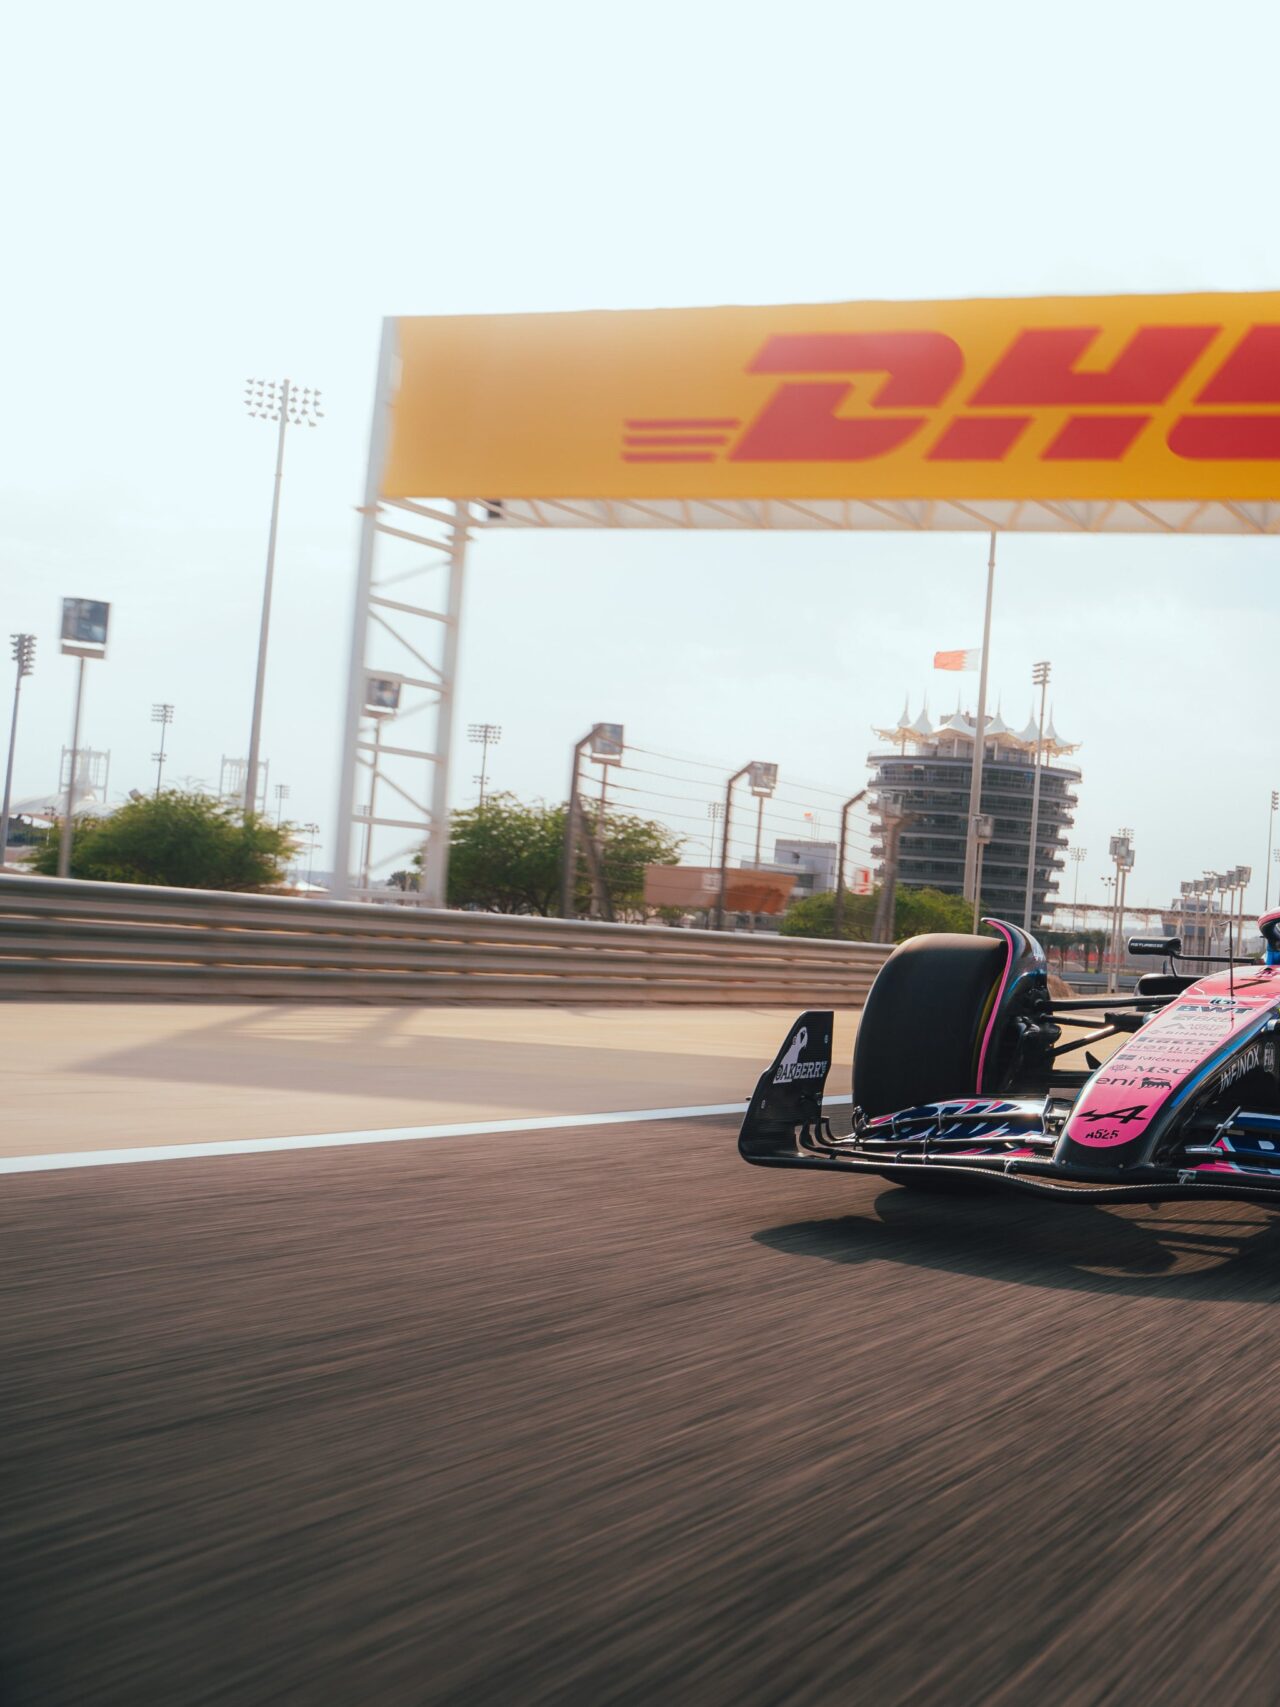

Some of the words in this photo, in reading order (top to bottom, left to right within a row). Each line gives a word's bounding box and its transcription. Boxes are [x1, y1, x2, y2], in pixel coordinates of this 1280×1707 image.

[1176, 1005, 1252, 1014] BWT
[1138, 1055, 1201, 1064] Microsoft
[775, 1060, 828, 1081] OAKBERRY
[1134, 1065, 1191, 1075] MSC
[1219, 1045, 1260, 1094] INFINOX
[1096, 1076, 1139, 1086] eni
